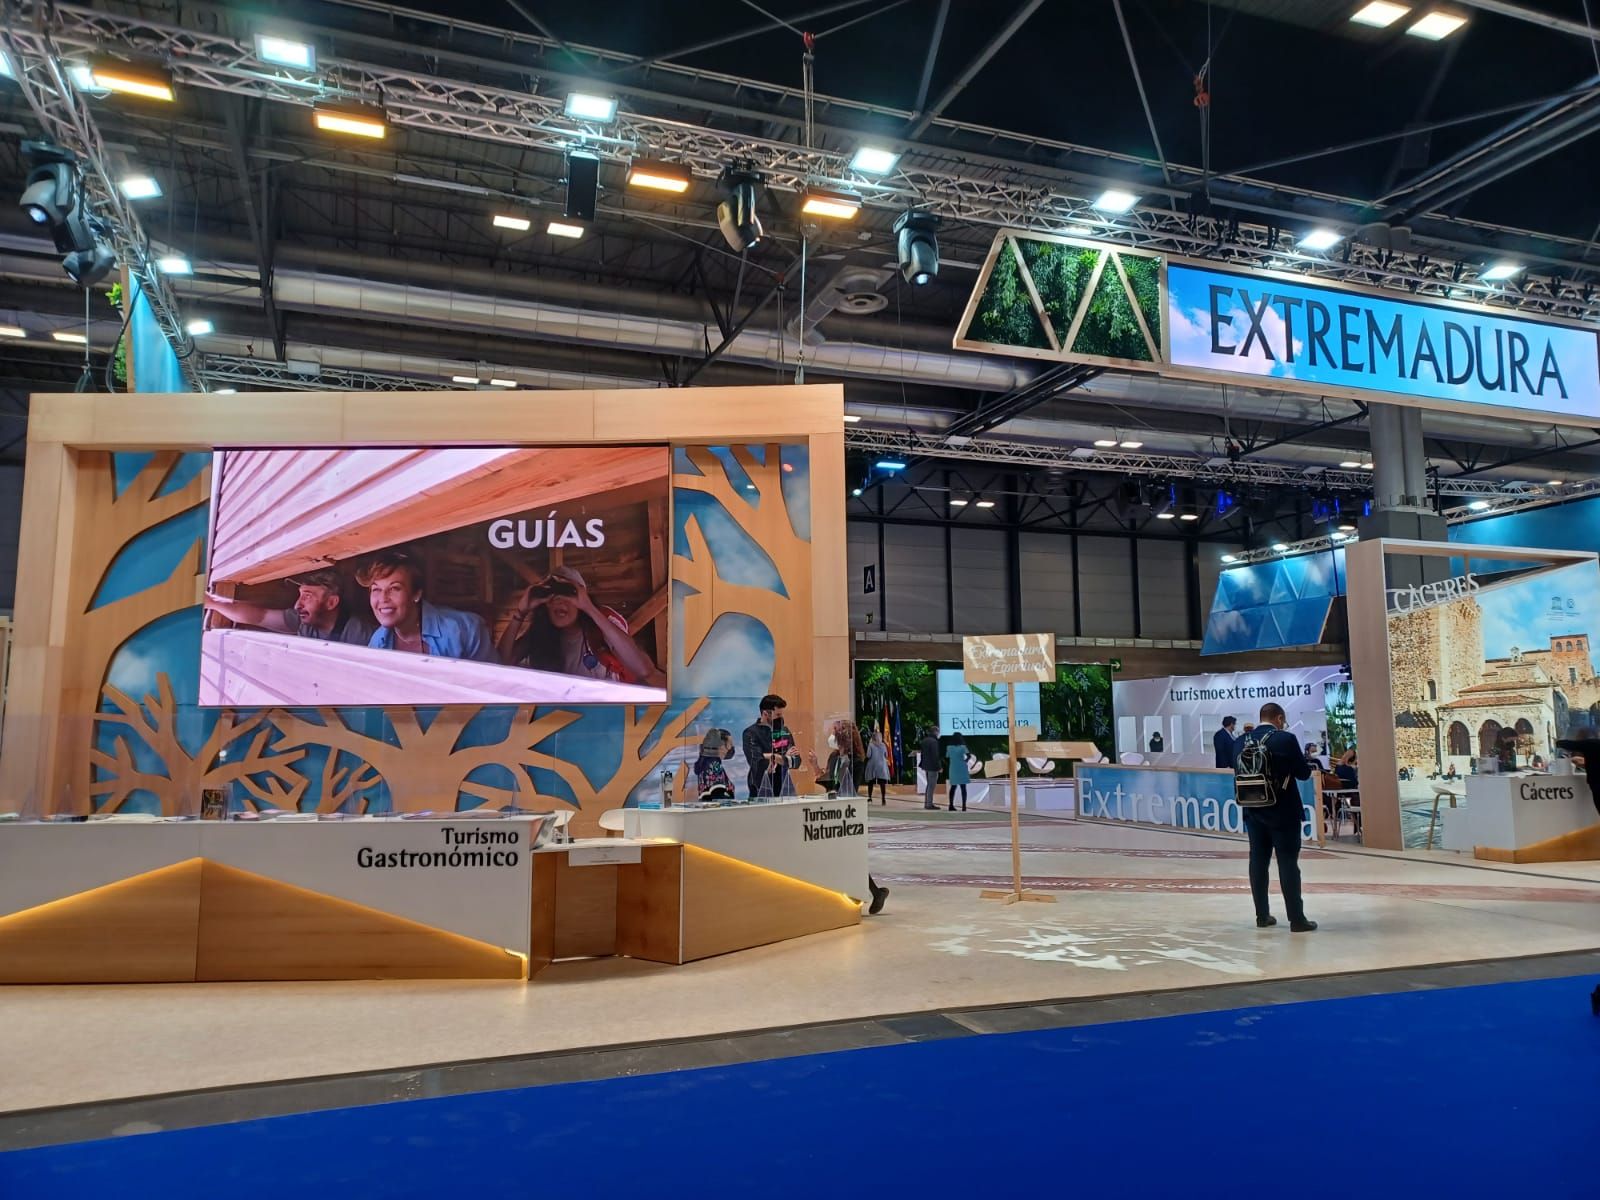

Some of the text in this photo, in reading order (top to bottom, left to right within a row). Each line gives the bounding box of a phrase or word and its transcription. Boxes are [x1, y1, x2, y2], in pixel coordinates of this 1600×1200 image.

[1208, 284, 1569, 399] EXTREMADURA
[488, 510, 605, 549] GUÍAS
[865, 569, 874, 590] A
[1170, 681, 1312, 702] turismoextremadura
[1520, 782, 1574, 801] Cáceres
[802, 799, 857, 822] Turismo de
[1077, 777, 1318, 842] Extremada
[441, 827, 519, 845] Turismo
[803, 819, 864, 842] Naturaleza
[356, 844, 519, 869] Gastronómico
